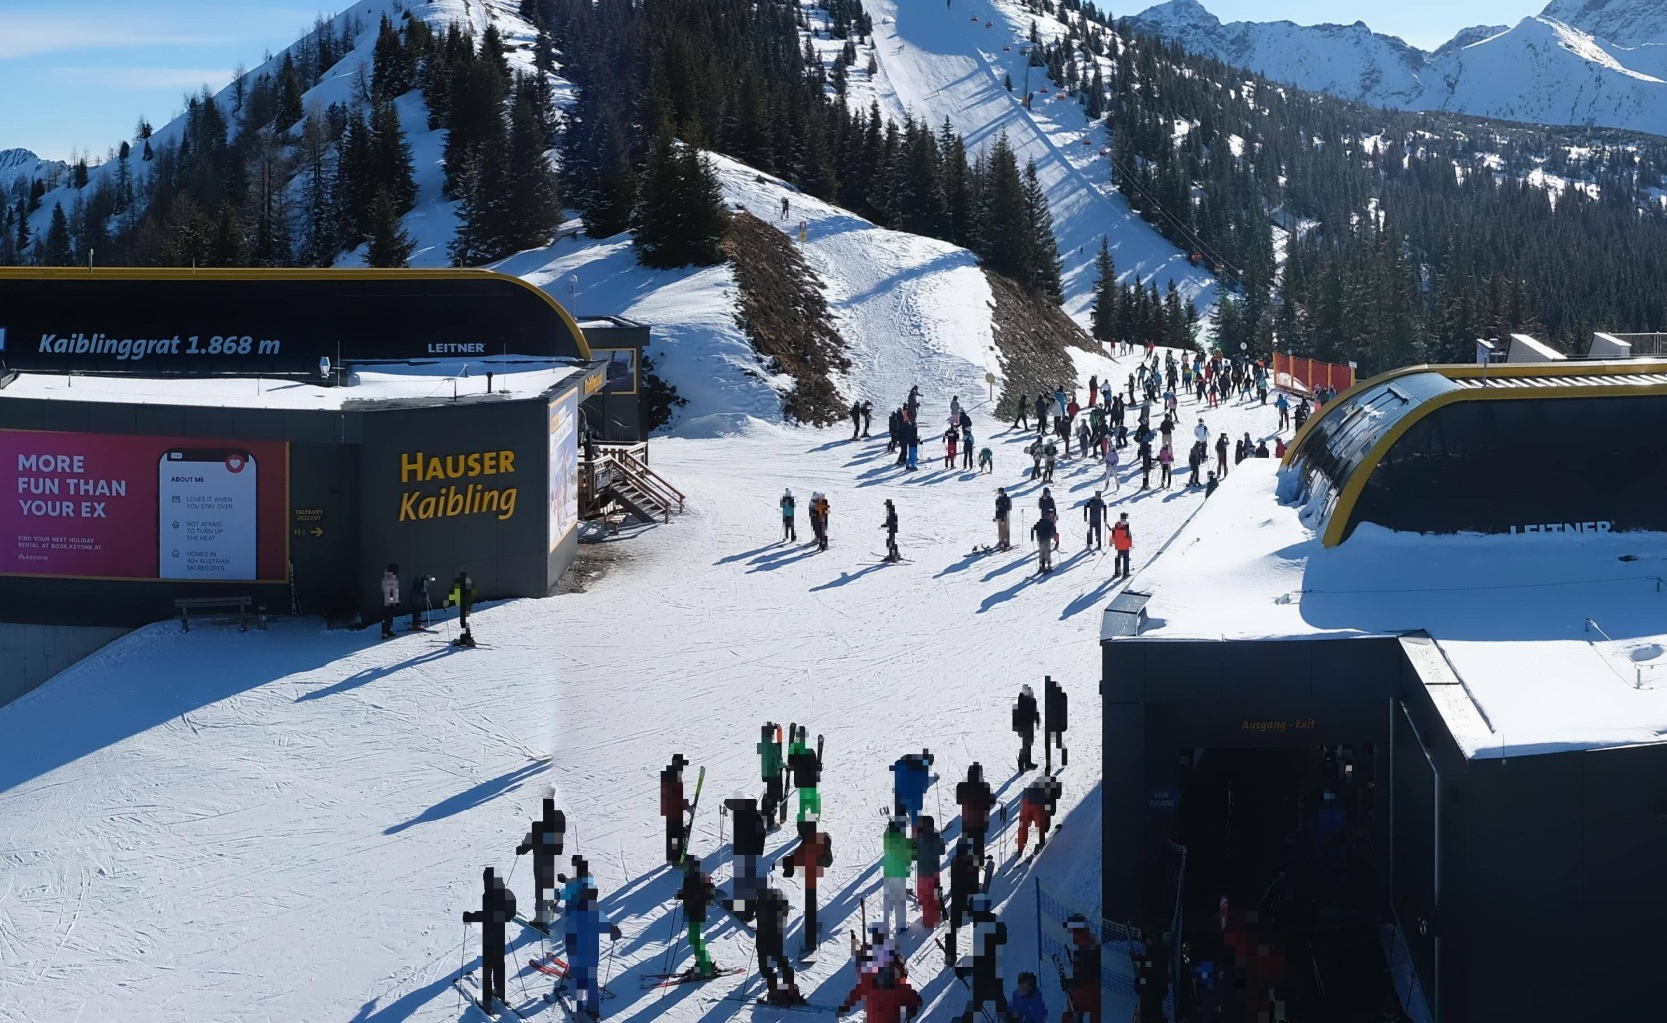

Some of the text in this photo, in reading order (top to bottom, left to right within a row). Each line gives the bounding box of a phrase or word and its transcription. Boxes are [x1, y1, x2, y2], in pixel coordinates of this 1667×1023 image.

[38, 333, 281, 360] Kaiblinggrat 1.868 m
[427, 342, 485, 353] LEITNER
[18, 454, 85, 473] MORE
[401, 449, 516, 483] HAUSER
[18, 477, 126, 497] FUN THAN
[19, 499, 107, 518] YOUR EX
[398, 483, 518, 522] Kaibling
[1241, 720, 1287, 732] Ausgang
[1295, 718, 1316, 729] Exit
